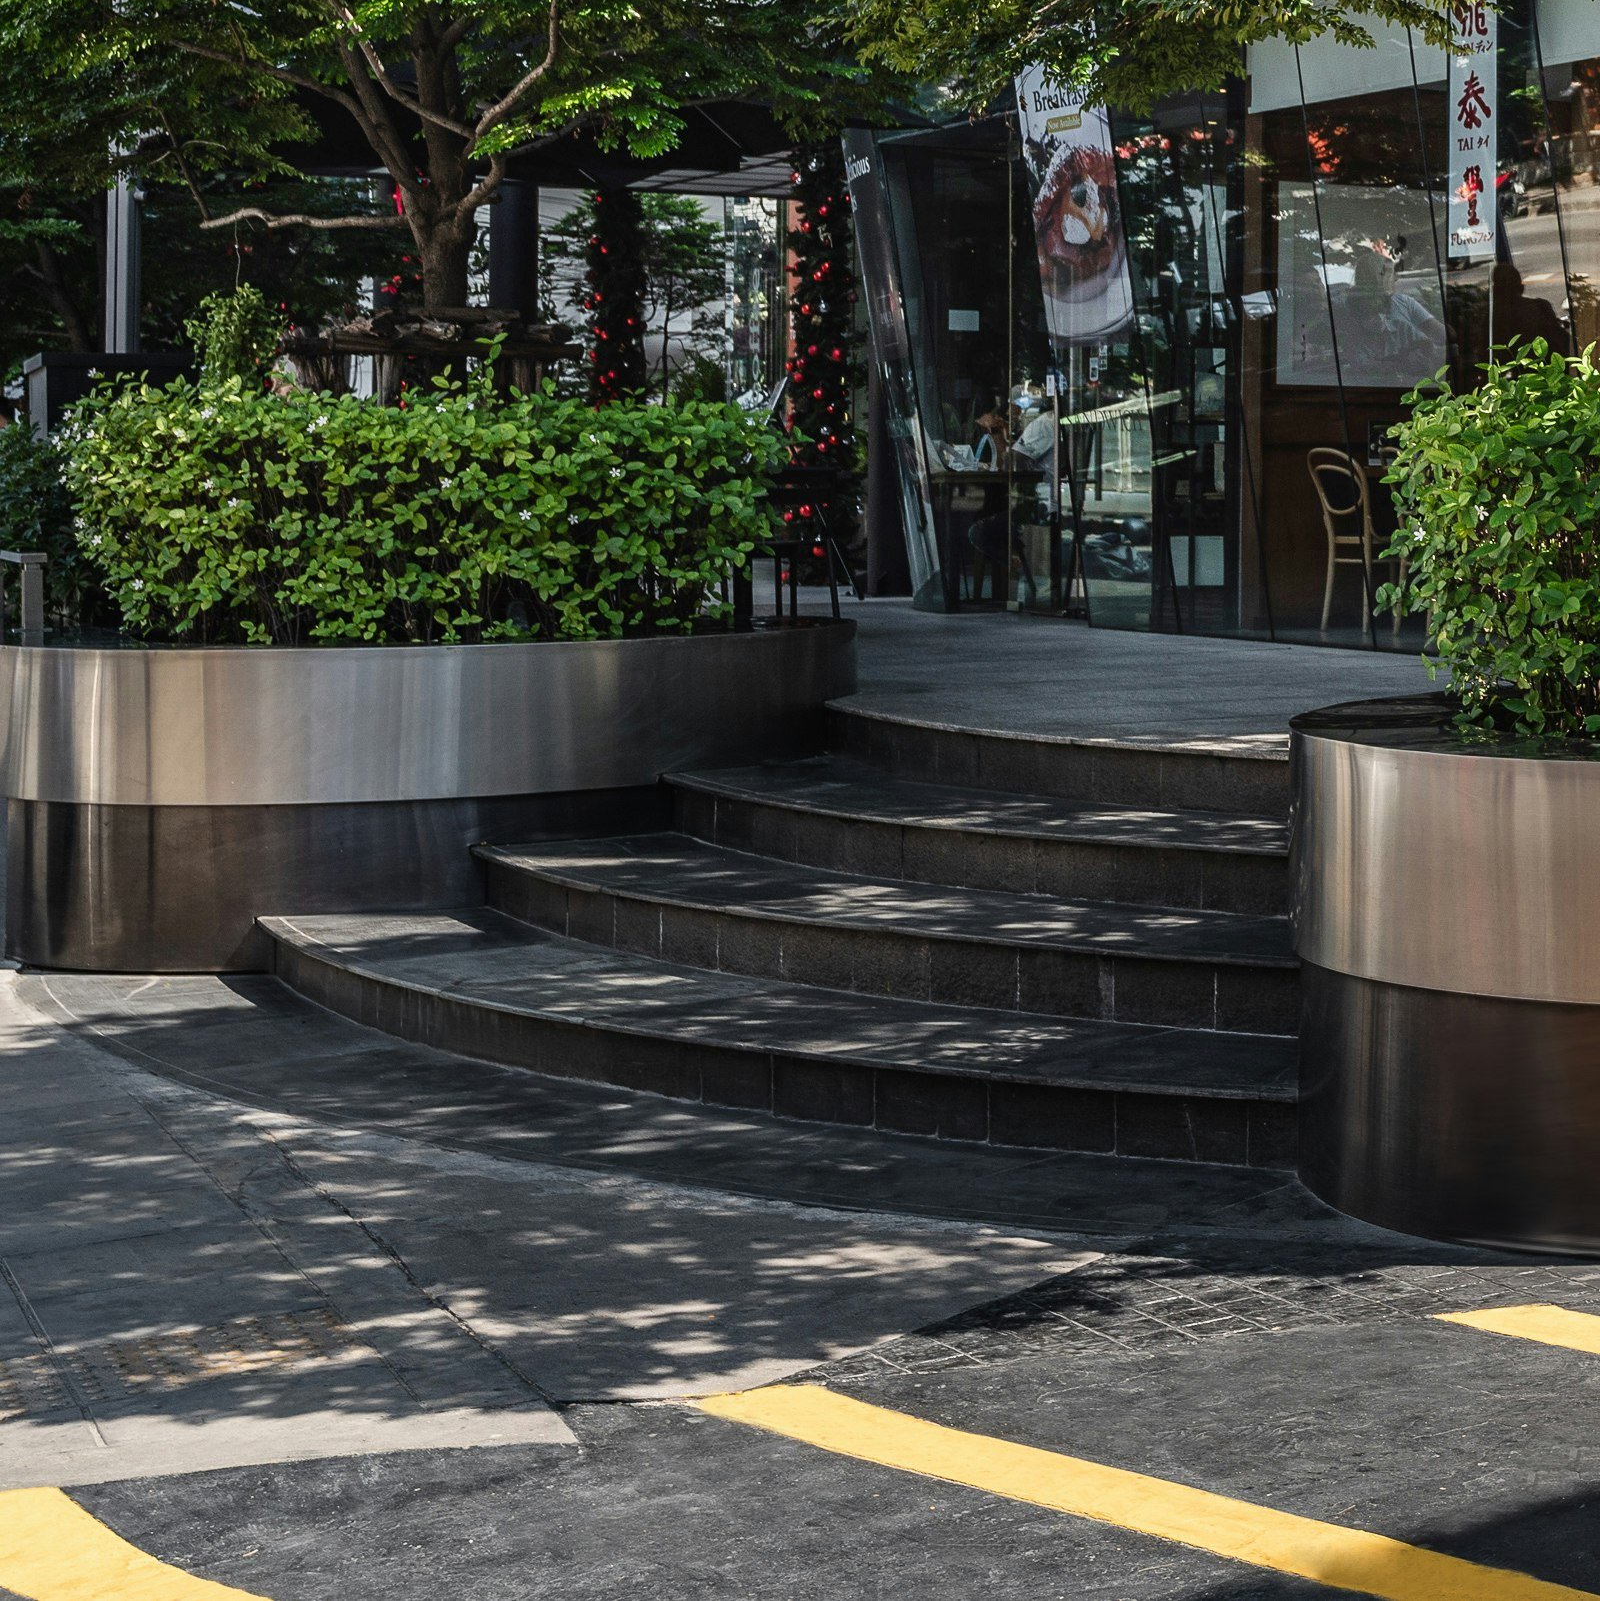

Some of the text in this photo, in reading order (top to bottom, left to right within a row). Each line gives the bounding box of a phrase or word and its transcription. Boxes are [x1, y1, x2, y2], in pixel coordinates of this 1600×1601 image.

[1032, 85, 1088, 113] Breakfast
[1456, 69, 1492, 130] 泰
[1457, 137, 1474, 152] TAI
